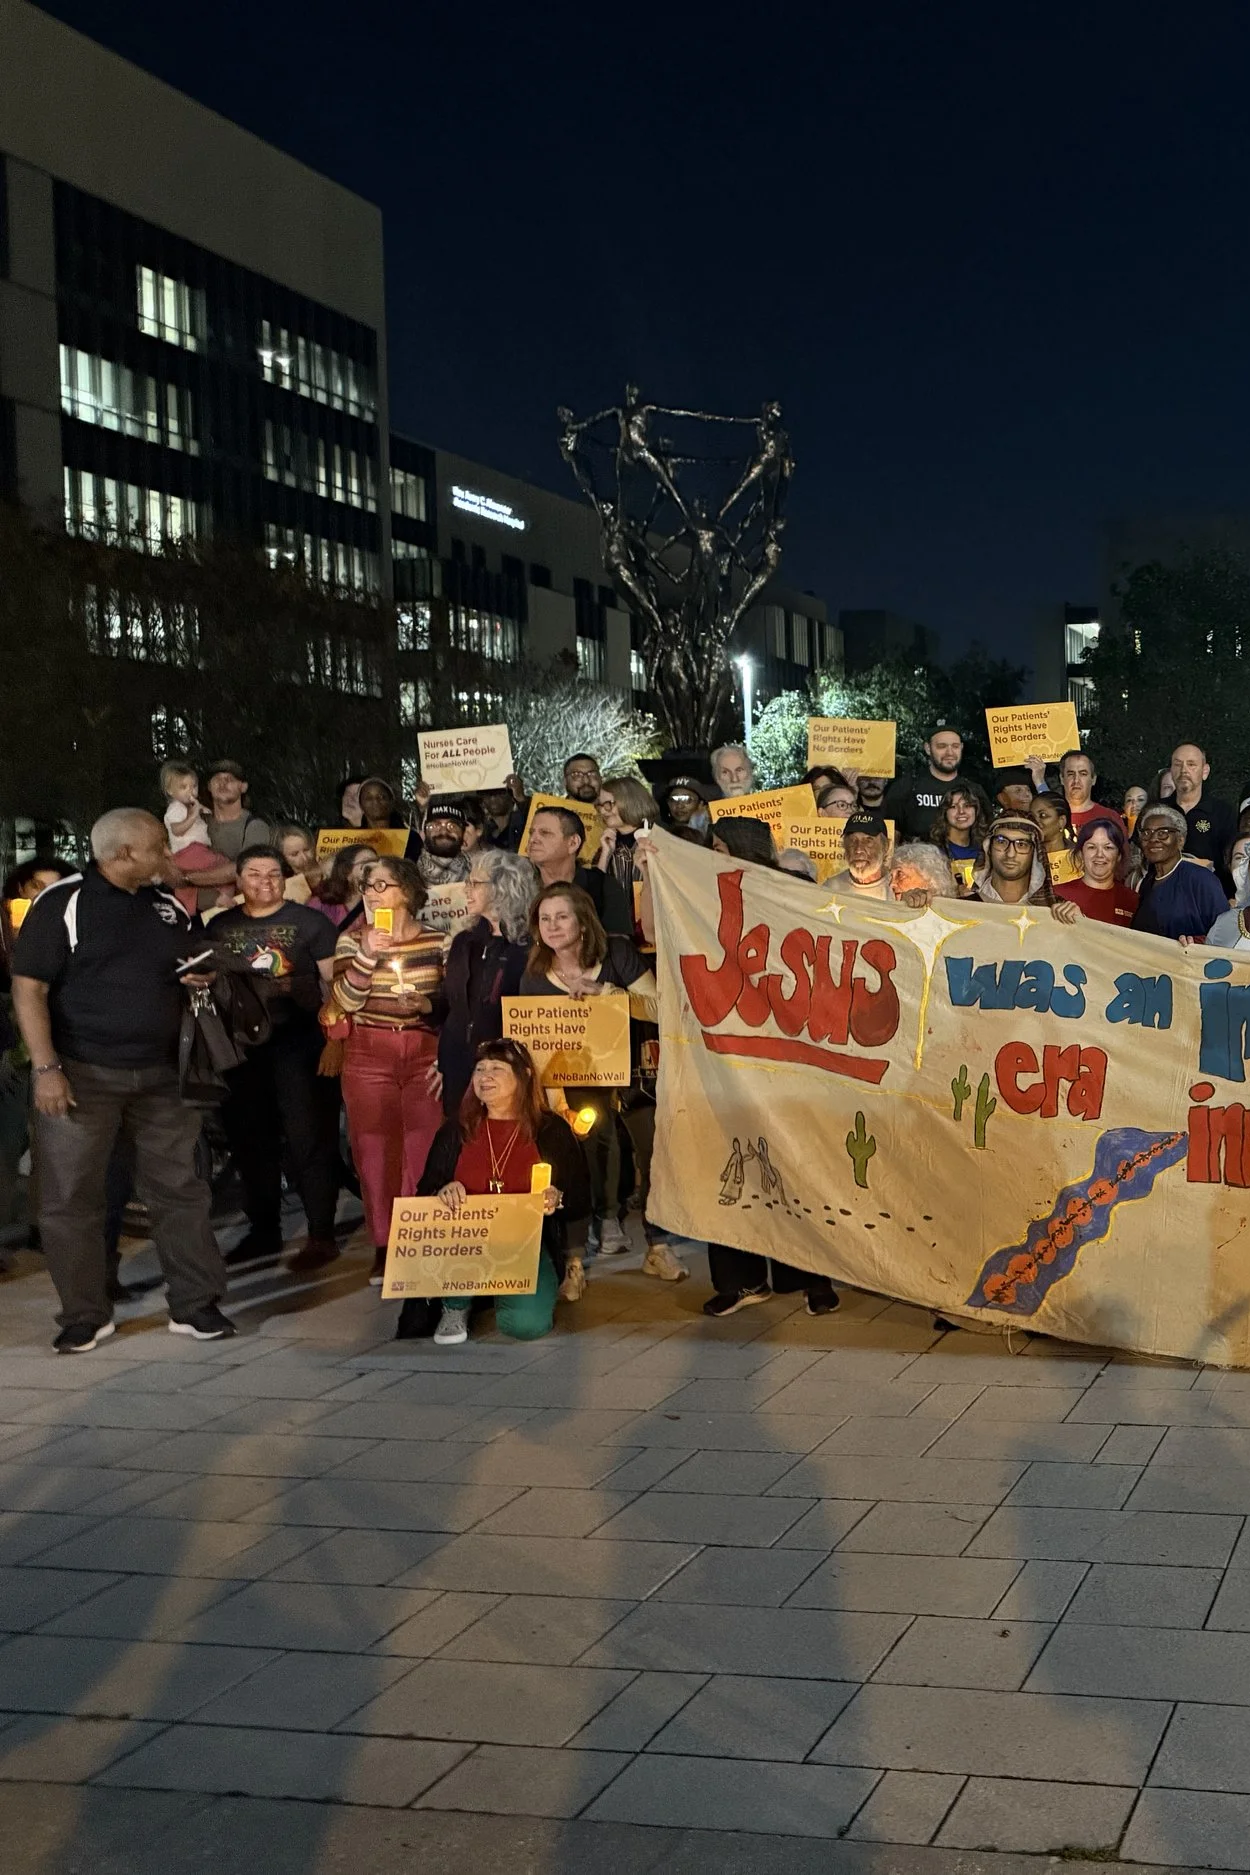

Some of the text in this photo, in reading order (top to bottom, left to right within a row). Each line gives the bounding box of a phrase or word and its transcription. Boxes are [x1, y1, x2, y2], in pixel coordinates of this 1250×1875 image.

[991, 714, 1009, 724] Our
[813, 724, 830, 733] Our
[992, 721, 1048, 734] Rights Have
[423, 736, 478, 750] Nurses Care
[812, 734, 866, 744] Rights Have
[994, 732, 1047, 745] No Borders
[424, 745, 496, 761] For ALL People
[812, 744, 864, 754] No Borders
[431, 805, 449, 815] MAX
[716, 808, 737, 817] Our
[790, 825, 812, 834] Our
[322, 836, 340, 844] Our
[789, 837, 826, 849] Rights
[828, 838, 844, 848] Ha
[431, 905, 469, 921] Peopl
[680, 869, 900, 1048] Jesus
[945, 956, 1088, 1019] was
[1105, 972, 1173, 1030] an
[509, 1007, 533, 1019] Our
[509, 1023, 586, 1037] Rights Have
[532, 1038, 583, 1051] Borders
[552, 1071, 625, 1081] #NoBanNoWall
[995, 1041, 1108, 1121] era
[400, 1209, 429, 1223] Our
[397, 1226, 489, 1242] Rights Have
[394, 1243, 483, 1258] No Borders
[441, 1278, 531, 1291] #NoBanNoWall
